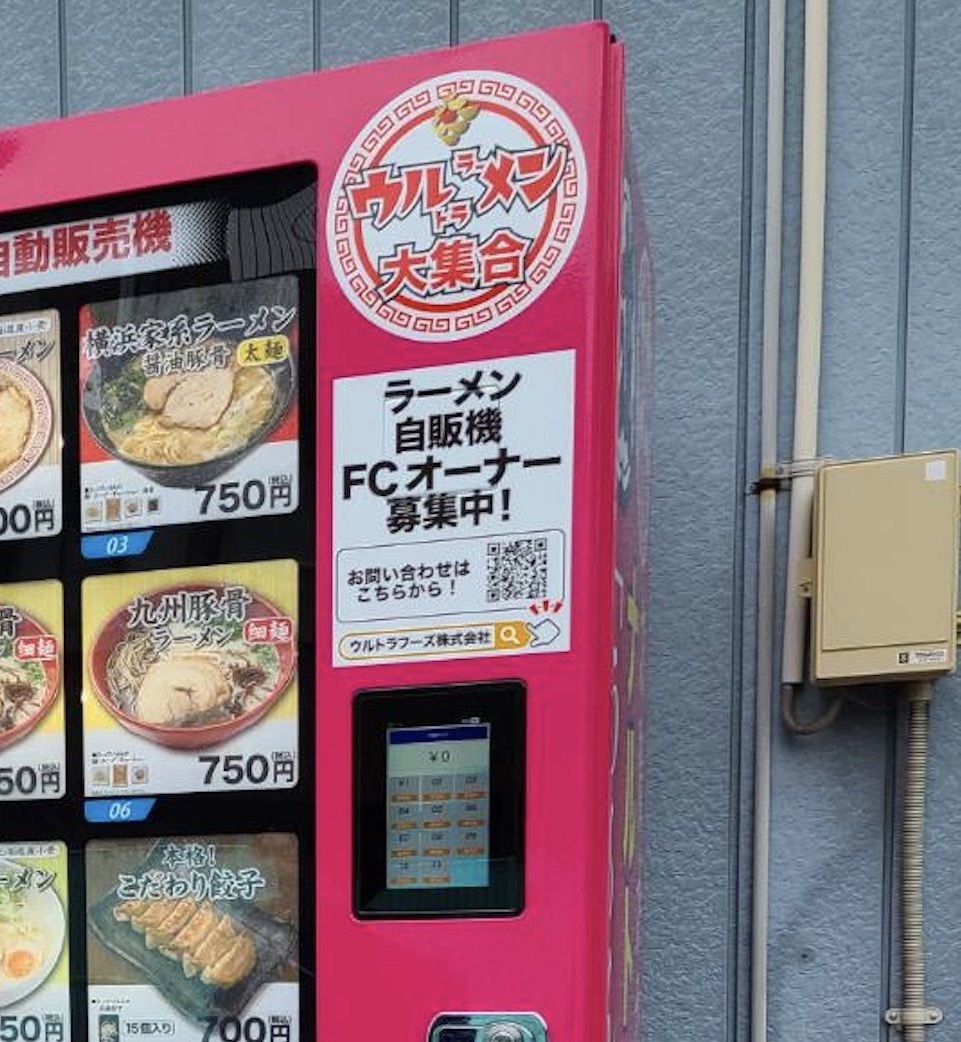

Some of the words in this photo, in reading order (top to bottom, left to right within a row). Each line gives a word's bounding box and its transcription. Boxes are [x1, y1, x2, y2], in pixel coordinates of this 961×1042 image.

[378, 228, 532, 300] 大集合
[84, 306, 297, 360] 横浜家系ラーメン
[144, 344, 232, 376] 醤油豚骨
[244, 342, 284, 362] 太麺
[384, 370, 522, 415] ラーメン
[395, 408, 502, 455] 自販機
[194, 479, 291, 515] 750円
[106, 537, 129, 554] 03
[347, 560, 470, 586] お問い合わせは
[127, 587, 252, 627] 九州豚骨
[153, 627, 233, 651] ラーメン
[247, 622, 290, 641] 細麺
[349, 630, 493, 654] ウルトラフーズ株式会社
[17, 640, 56, 658] 細麺
[198, 754, 295, 785] 750円
[109, 803, 131, 818] 06
[117, 868, 266, 900] こだわり餃子
[126, 1022, 172, 1034] 15個入り
